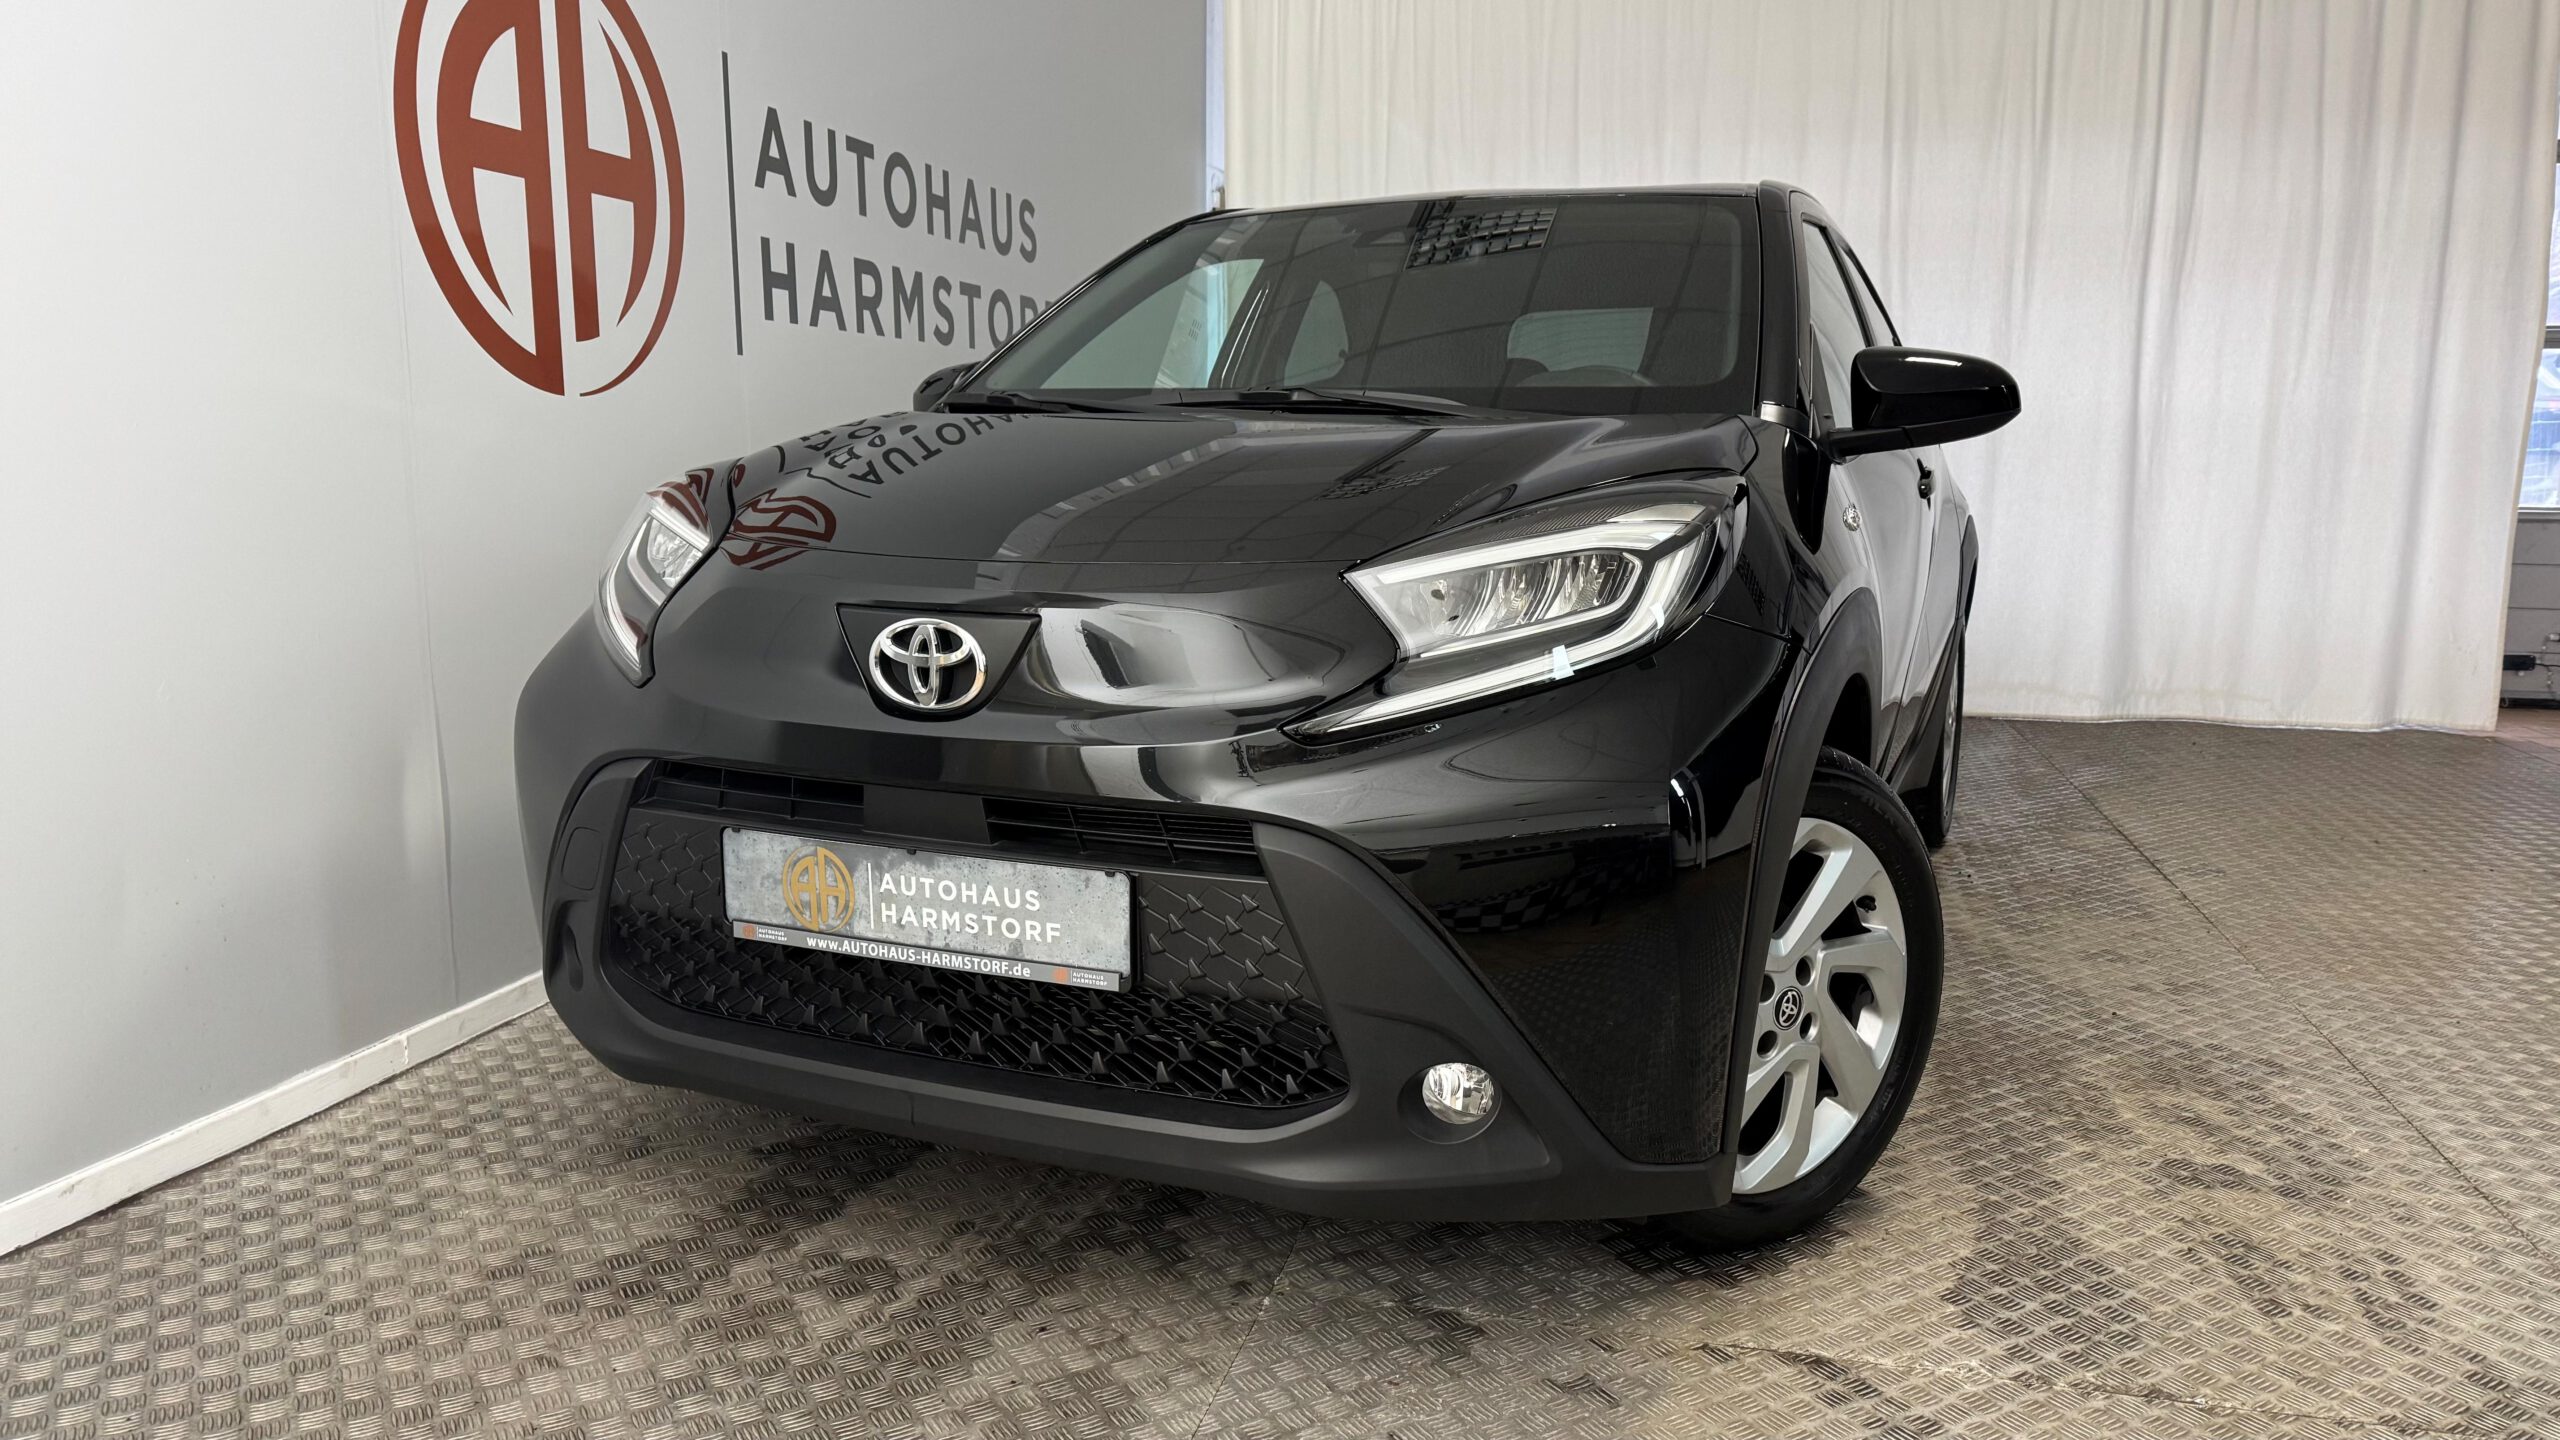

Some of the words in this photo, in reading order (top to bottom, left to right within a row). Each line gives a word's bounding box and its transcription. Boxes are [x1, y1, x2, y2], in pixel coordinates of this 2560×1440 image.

[754, 106, 1037, 263] AUTOHAUS
[760, 236, 1055, 350] HARMSTOR
[880, 873, 1040, 911] AUTOHAUS
[881, 903, 1061, 943] HARMSTORF
[807, 937, 1031, 978] www.AUTOHAUS-HARMSTORF.de
[1072, 972, 1104, 980] AUTOHAUS
[1072, 978, 1108, 986] HARMSTORF
